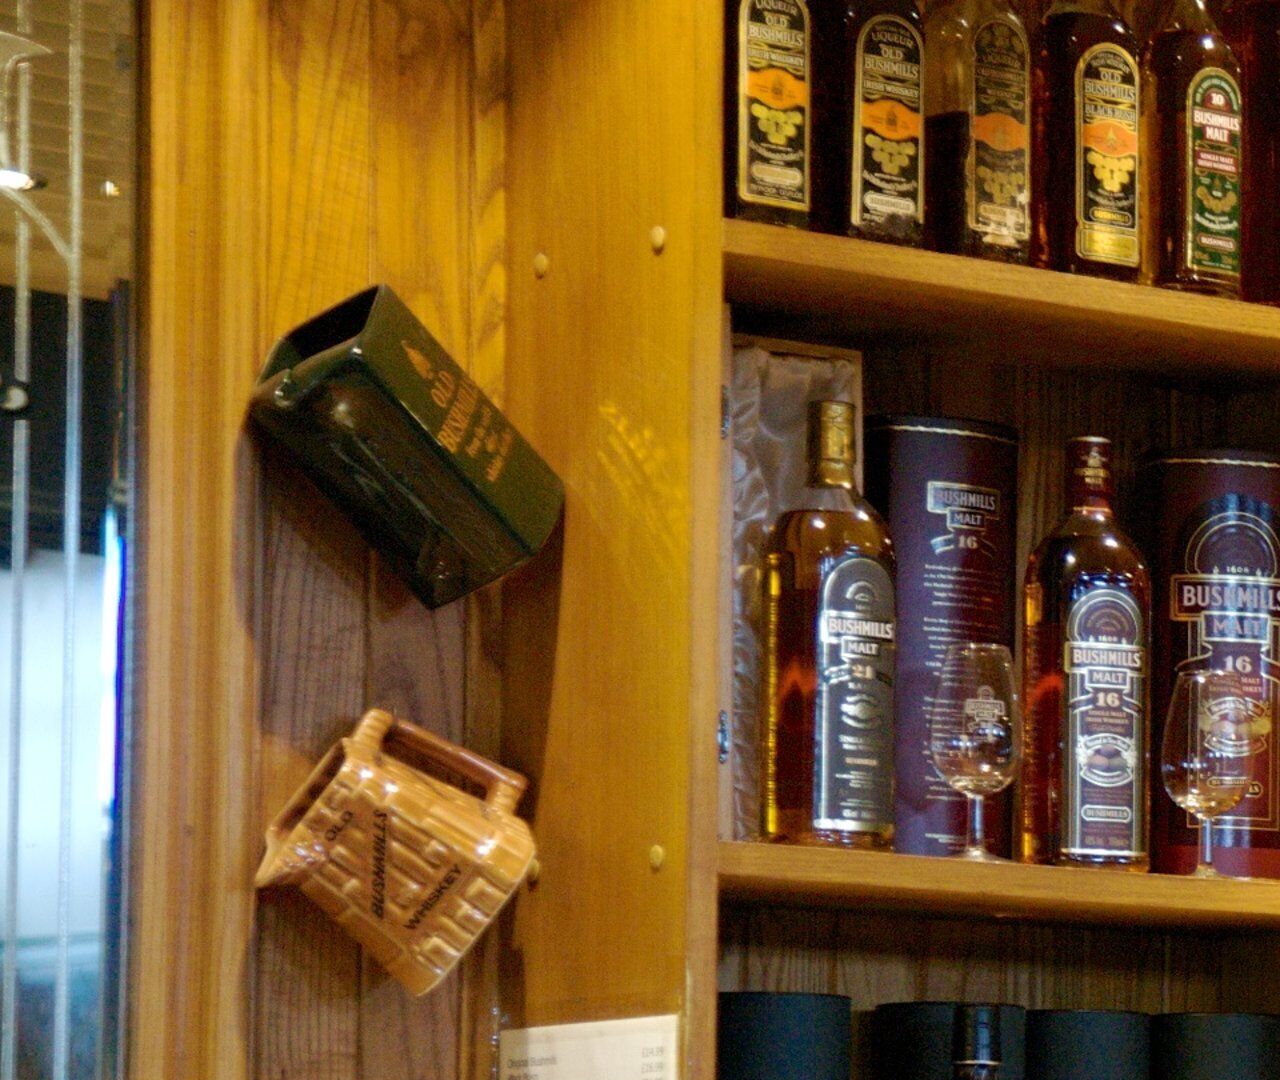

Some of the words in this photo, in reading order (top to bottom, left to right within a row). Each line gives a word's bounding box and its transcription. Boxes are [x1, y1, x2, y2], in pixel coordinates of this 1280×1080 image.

[765, 14, 789, 28] OLD
[749, 22, 805, 45] BUSHMILLS
[881, 46, 904, 60] OLD
[864, 56, 920, 79] BUSHMILLS
[1100, 71, 1122, 84] OLD
[1084, 79, 1136, 101] BUSHMILLS
[1210, 92, 1225, 106] 10
[1193, 110, 1240, 131] BUSHMILLS
[1205, 127, 1231, 144] MALT
[1201, 236, 1235, 250] BUSHMILLS
[430, 370, 455, 410] OLD
[939, 488, 997, 512] BUSHMILLS
[953, 512, 983, 527] MALT
[957, 534, 979, 550] 16
[1225, 564, 1250, 575] 1608
[828, 617, 894, 640] BUSHMILLS
[1213, 617, 1262, 636] MALT
[850, 639, 879, 656] MALT
[1072, 649, 1142, 669] BUSHMILLS
[1222, 653, 1254, 674] 16
[852, 664, 874, 679] 21
[1091, 670, 1125, 686] MALT
[1095, 691, 1121, 708] 16
[1086, 808, 1129, 820] BUSHMILLS
[323, 808, 355, 843] OLD
[370, 803, 388, 922] BUSHMILLS
[404, 862, 465, 932] WHISKEY
